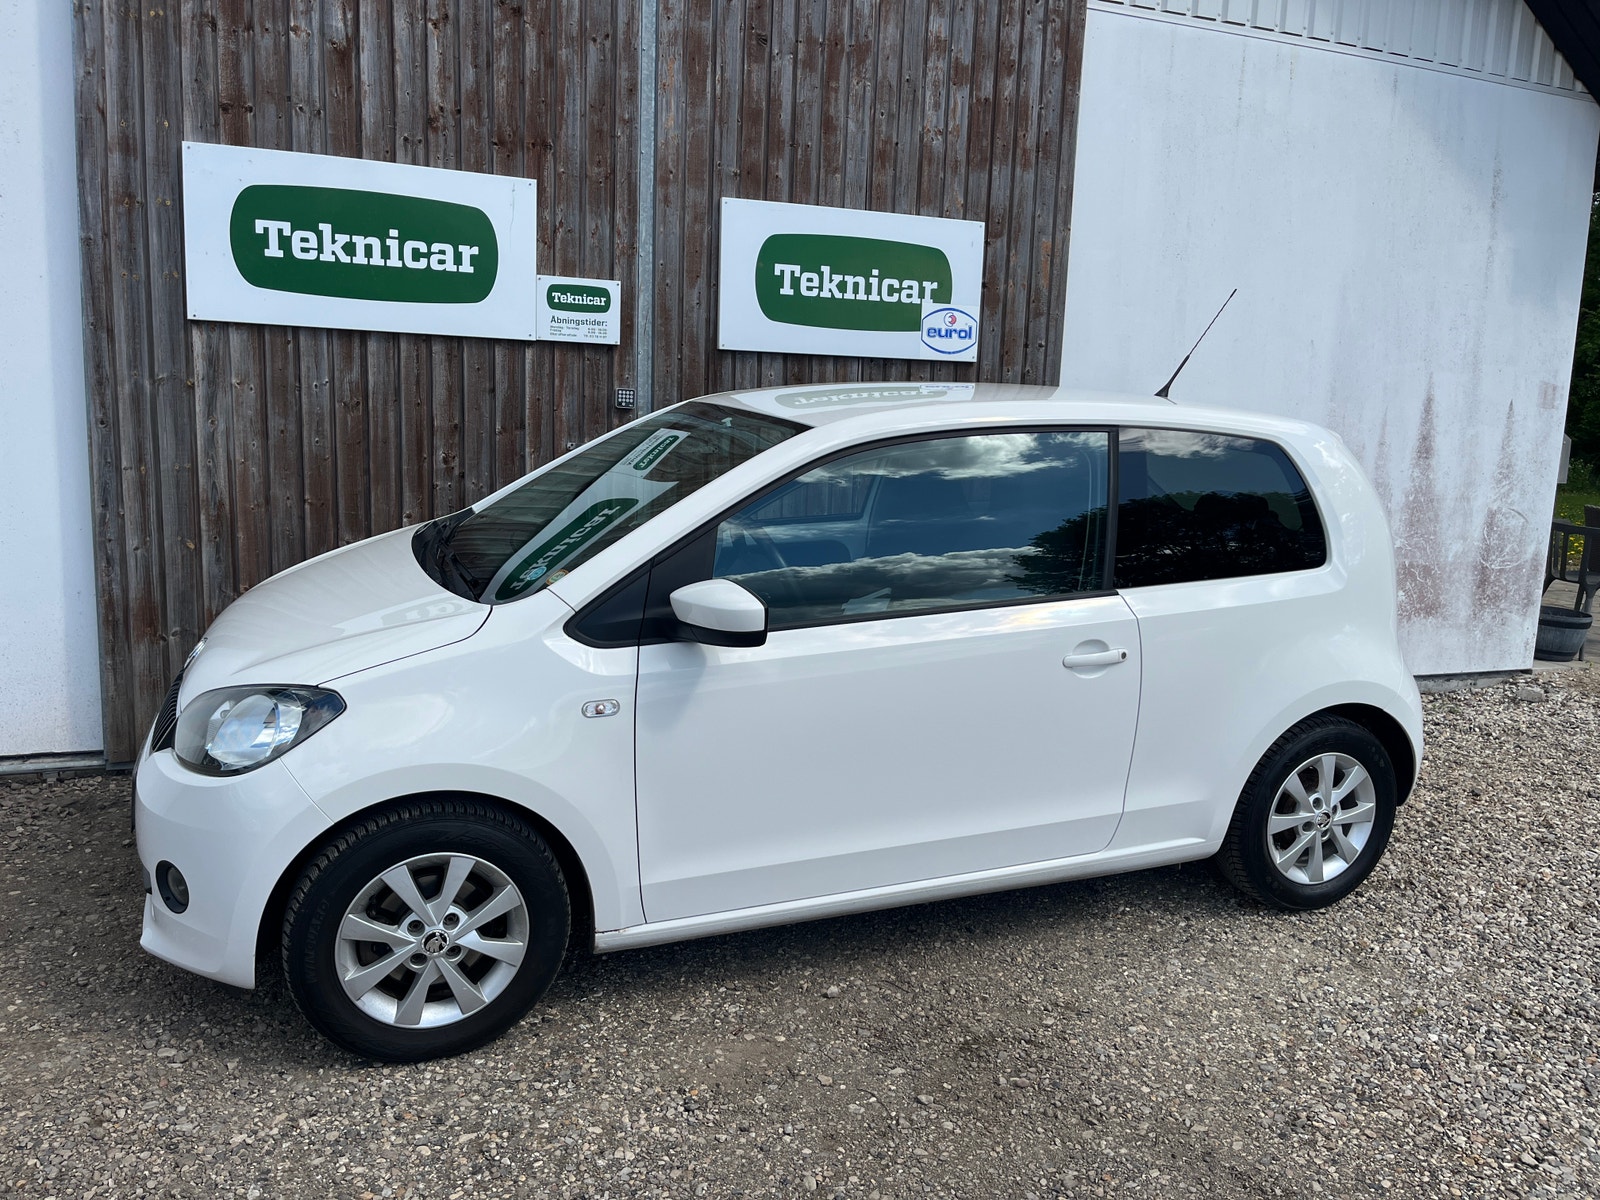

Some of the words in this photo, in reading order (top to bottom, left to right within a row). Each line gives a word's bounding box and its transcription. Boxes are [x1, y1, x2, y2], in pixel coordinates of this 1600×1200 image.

[254, 218, 480, 274] Teknicar
[774, 263, 938, 304] Teknicar
[551, 292, 607, 306] Teknicar
[927, 325, 973, 340] eurol
